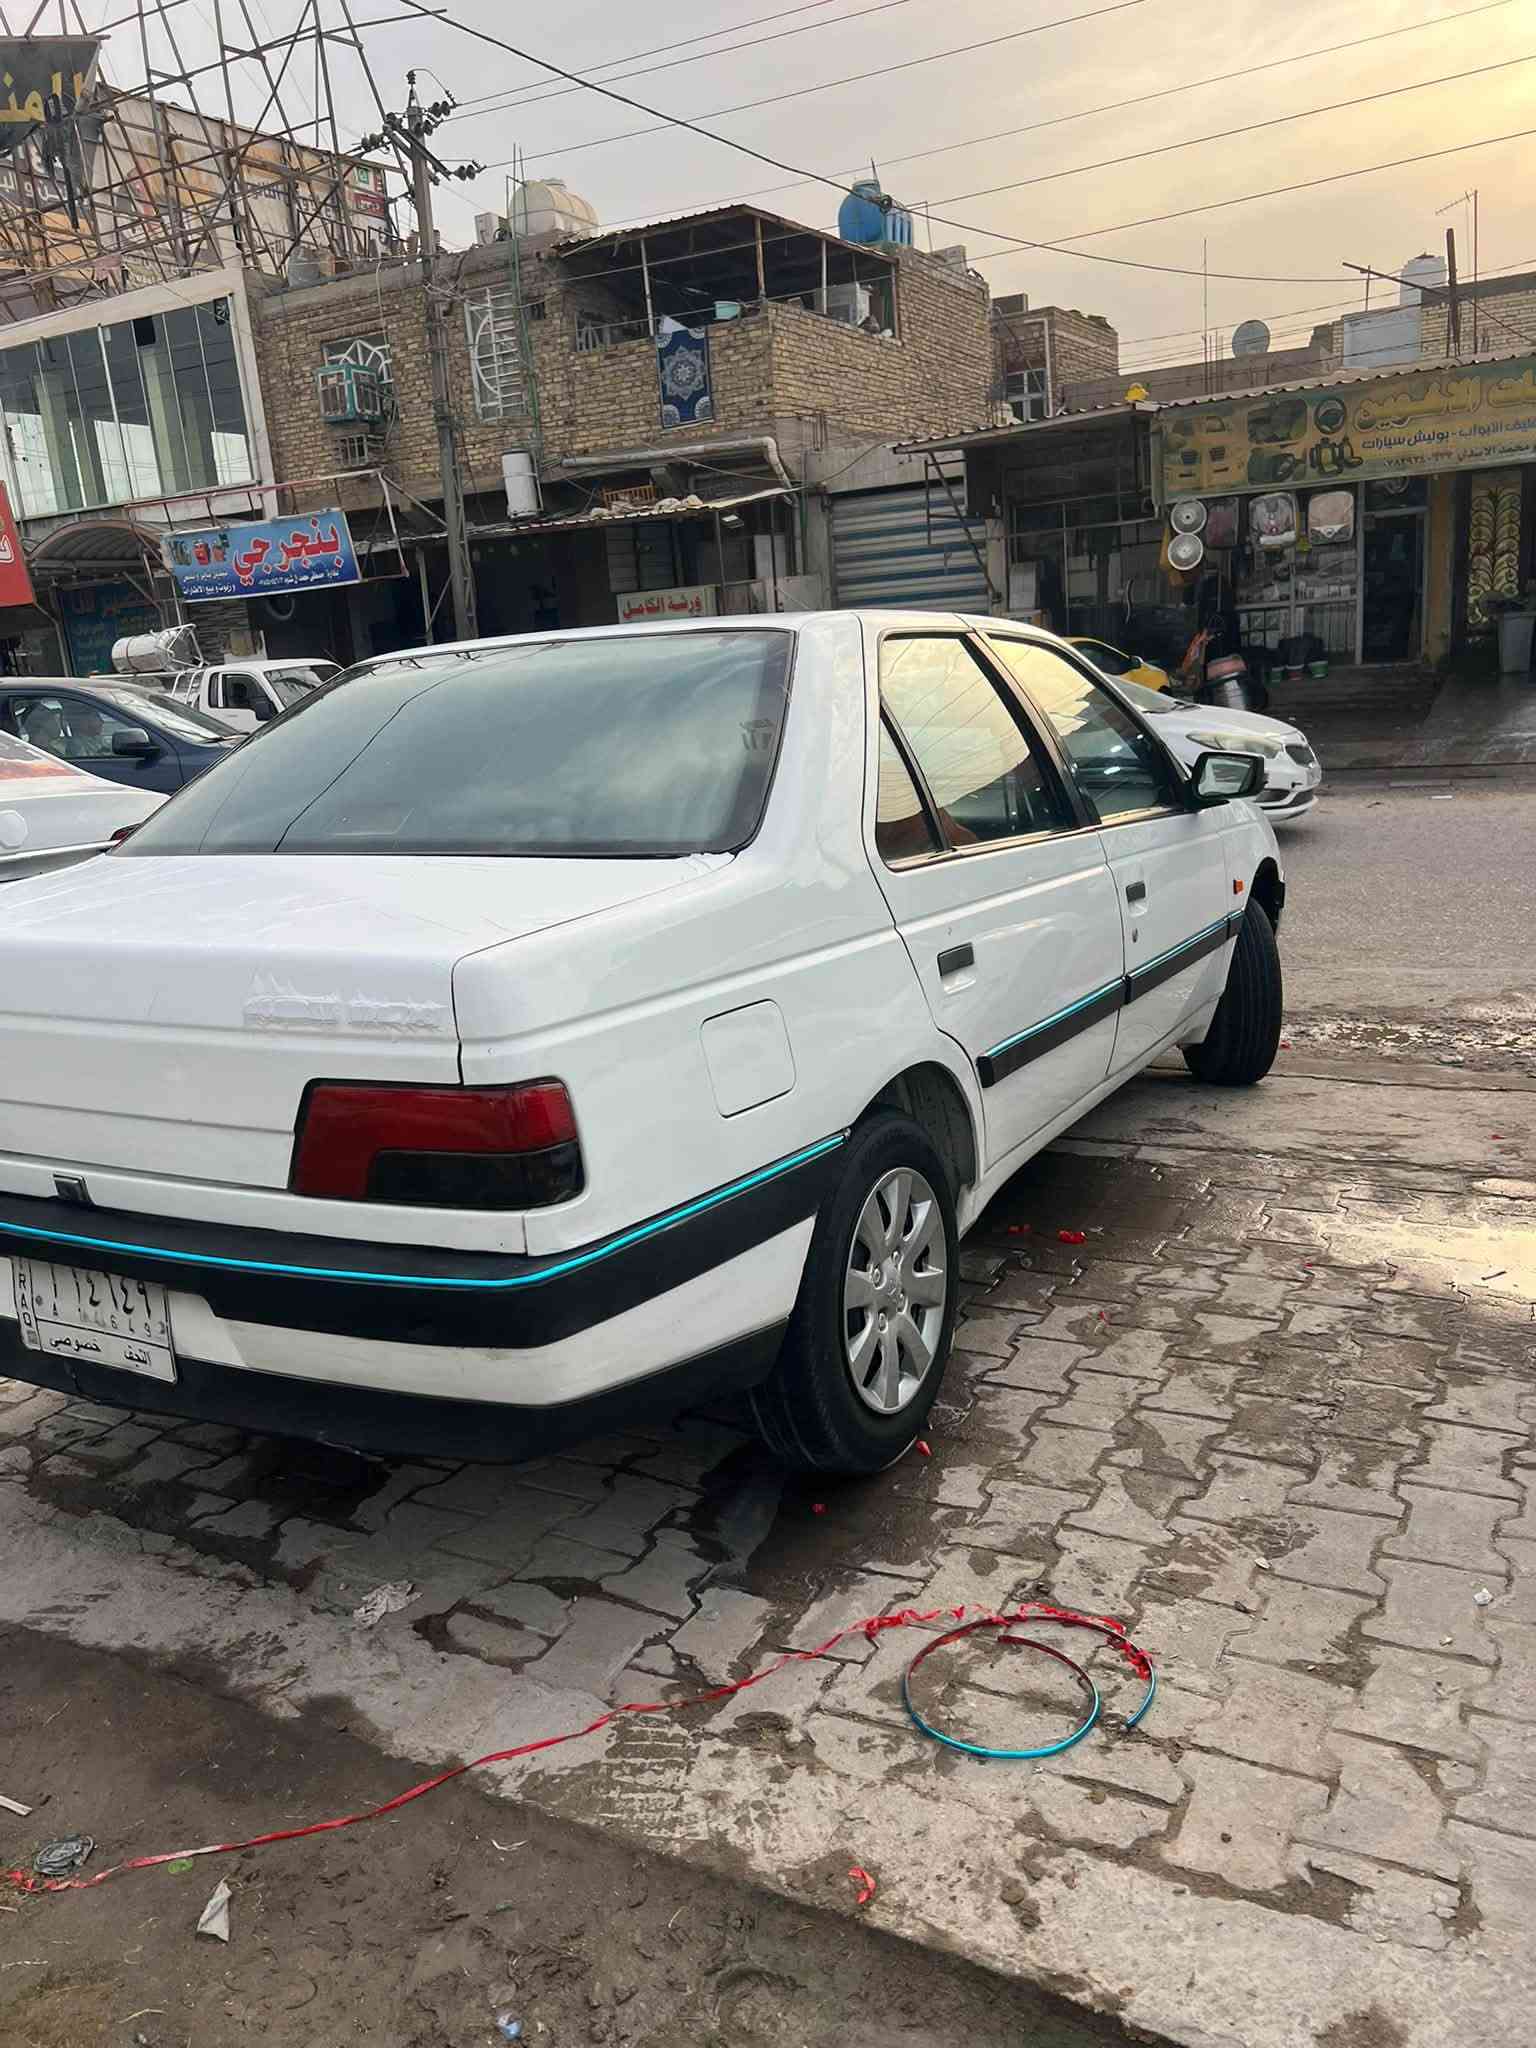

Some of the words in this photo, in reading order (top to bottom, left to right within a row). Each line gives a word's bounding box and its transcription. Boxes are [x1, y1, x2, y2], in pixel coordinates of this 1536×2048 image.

[232, 516, 344, 586] بنجرجي
[623, 597, 665, 619] الكامل
[667, 594, 704, 617] ورشة
[50, 1335, 102, 1353] خصوصي
